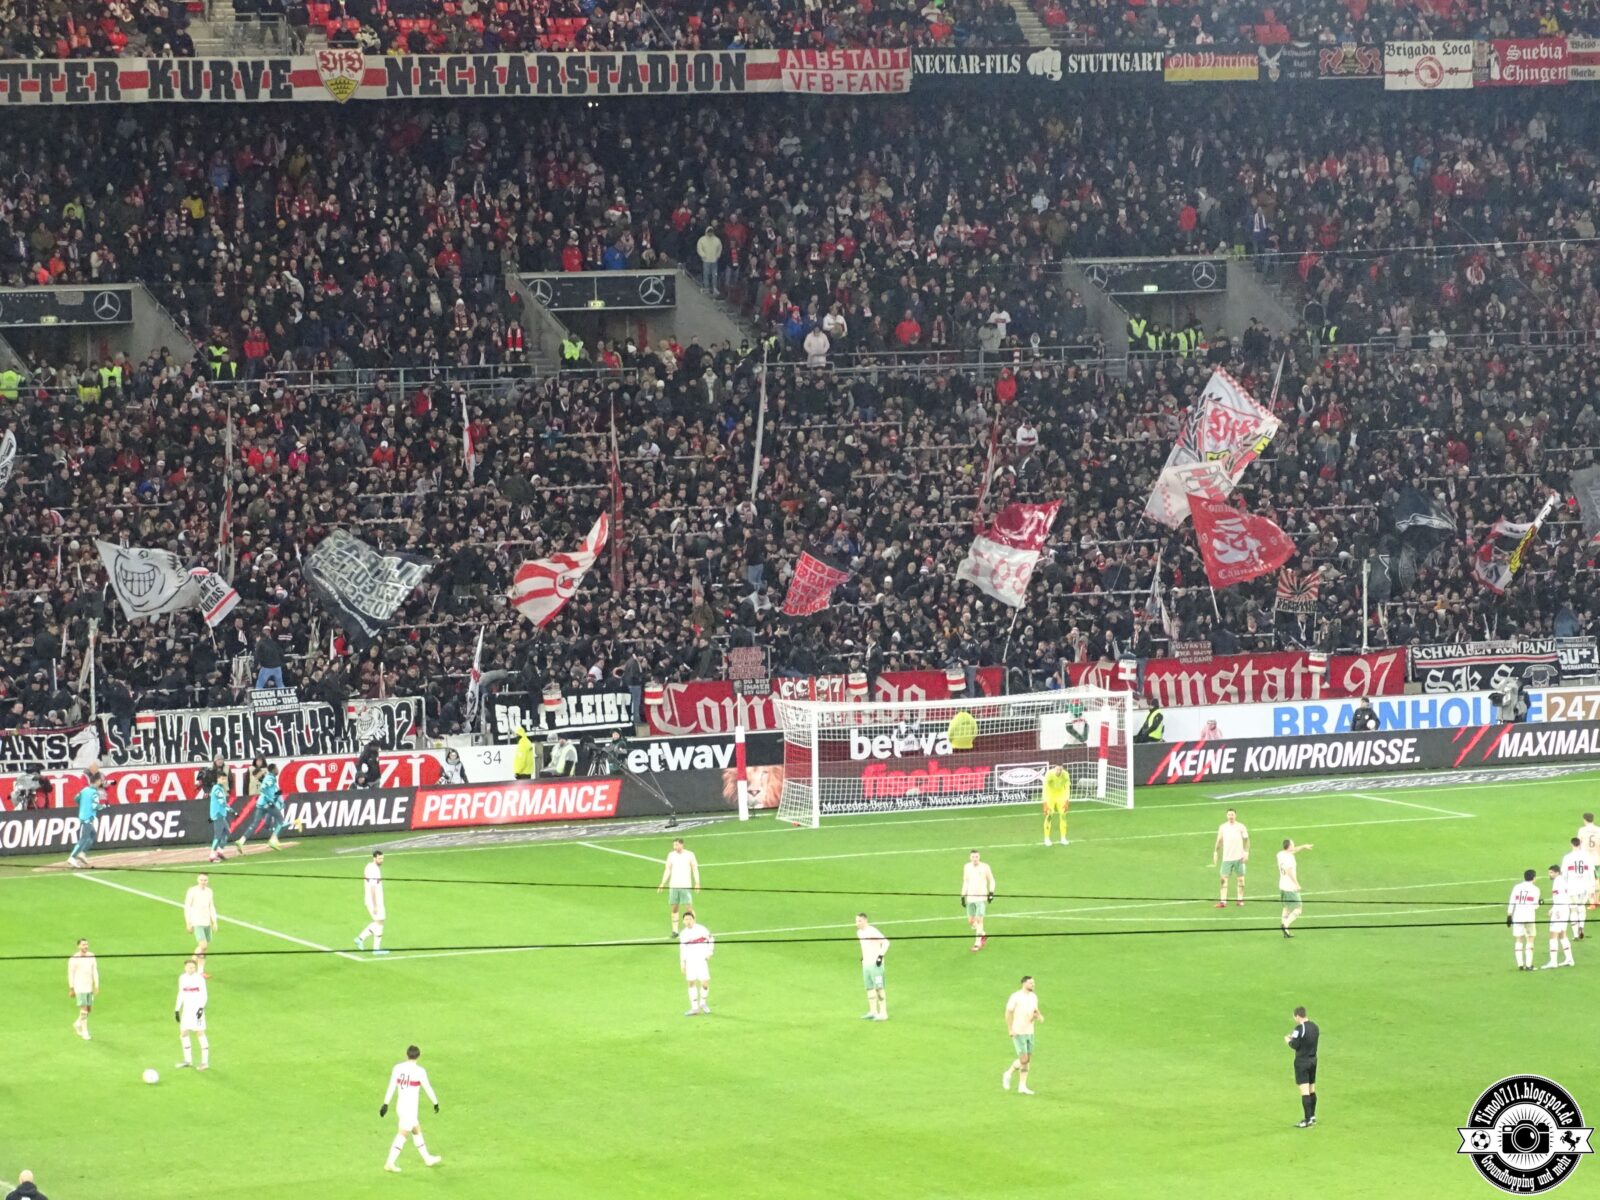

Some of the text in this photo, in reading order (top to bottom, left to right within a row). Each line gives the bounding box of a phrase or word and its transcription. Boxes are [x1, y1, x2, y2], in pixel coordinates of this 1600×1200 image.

[785, 48, 910, 70] ALBSTADT
[913, 51, 1164, 75] NECKAR-FILS STUTTGART
[1169, 52, 1199, 69] Old
[1385, 41, 1471, 60] Brigada Loca
[1506, 43, 1563, 61] Suebia
[148, 58, 293, 101] KURVE
[385, 52, 747, 97] NECKARSTADION
[789, 71, 906, 93] VFB-FANS
[1343, 653, 1397, 697] 97
[627, 743, 735, 774] etway
[1167, 737, 1421, 777] KEINE KOMPROMISSE.
[423, 784, 613, 823] PERFORMANCE.
